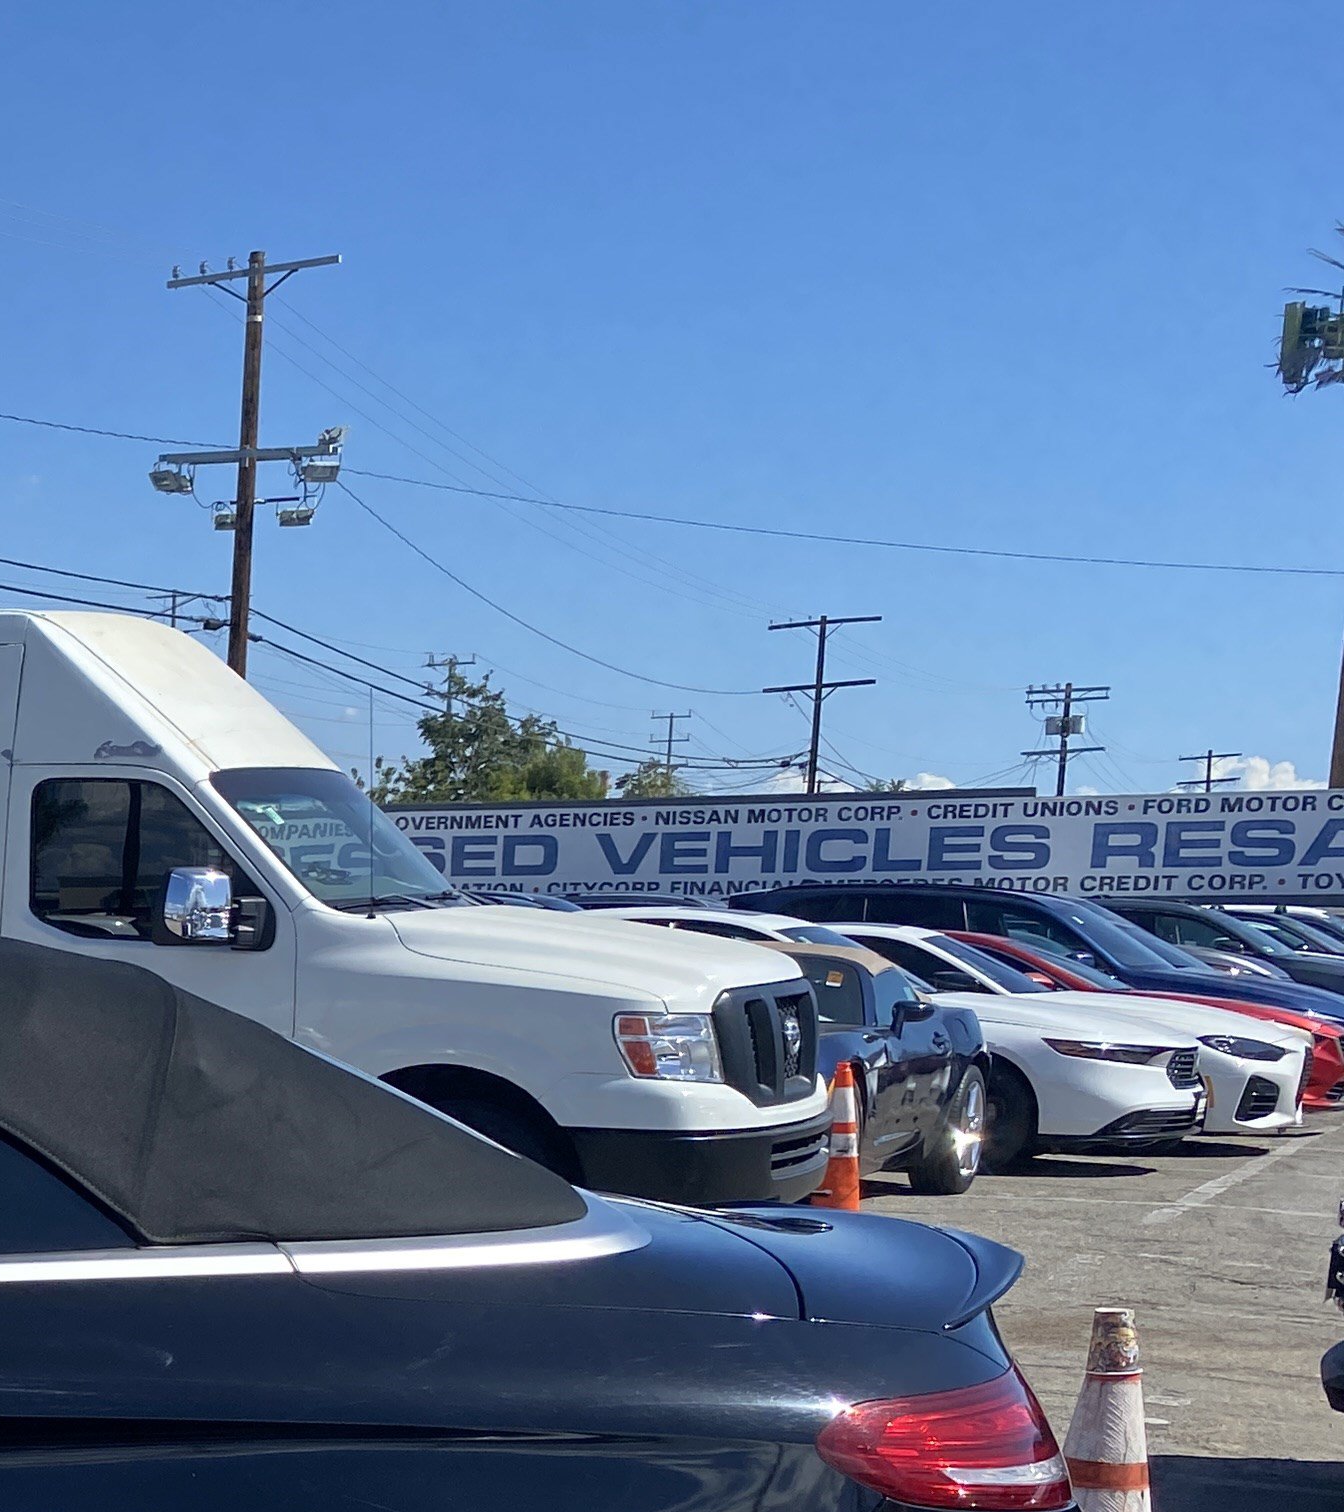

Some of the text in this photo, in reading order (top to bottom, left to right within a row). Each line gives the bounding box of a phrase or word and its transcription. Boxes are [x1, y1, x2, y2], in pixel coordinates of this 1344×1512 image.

[260, 823, 354, 841] OMPANIES
[396, 813, 523, 831] OVERNMENT
[529, 811, 635, 828] AGENCIES
[655, 809, 739, 826] NISSAN
[747, 808, 829, 824] MOTOR
[837, 805, 903, 822] CORP.
[927, 803, 1014, 820] CREDIT
[1022, 801, 1119, 817] UNIONS
[1142, 797, 1211, 815] FORD
[1220, 795, 1317, 813] MOTOR
[409, 834, 559, 877] SED
[595, 824, 1051, 875] VEHICLES
[1079, 875, 1179, 892] CREDIT
[1186, 873, 1268, 891] CORP.
